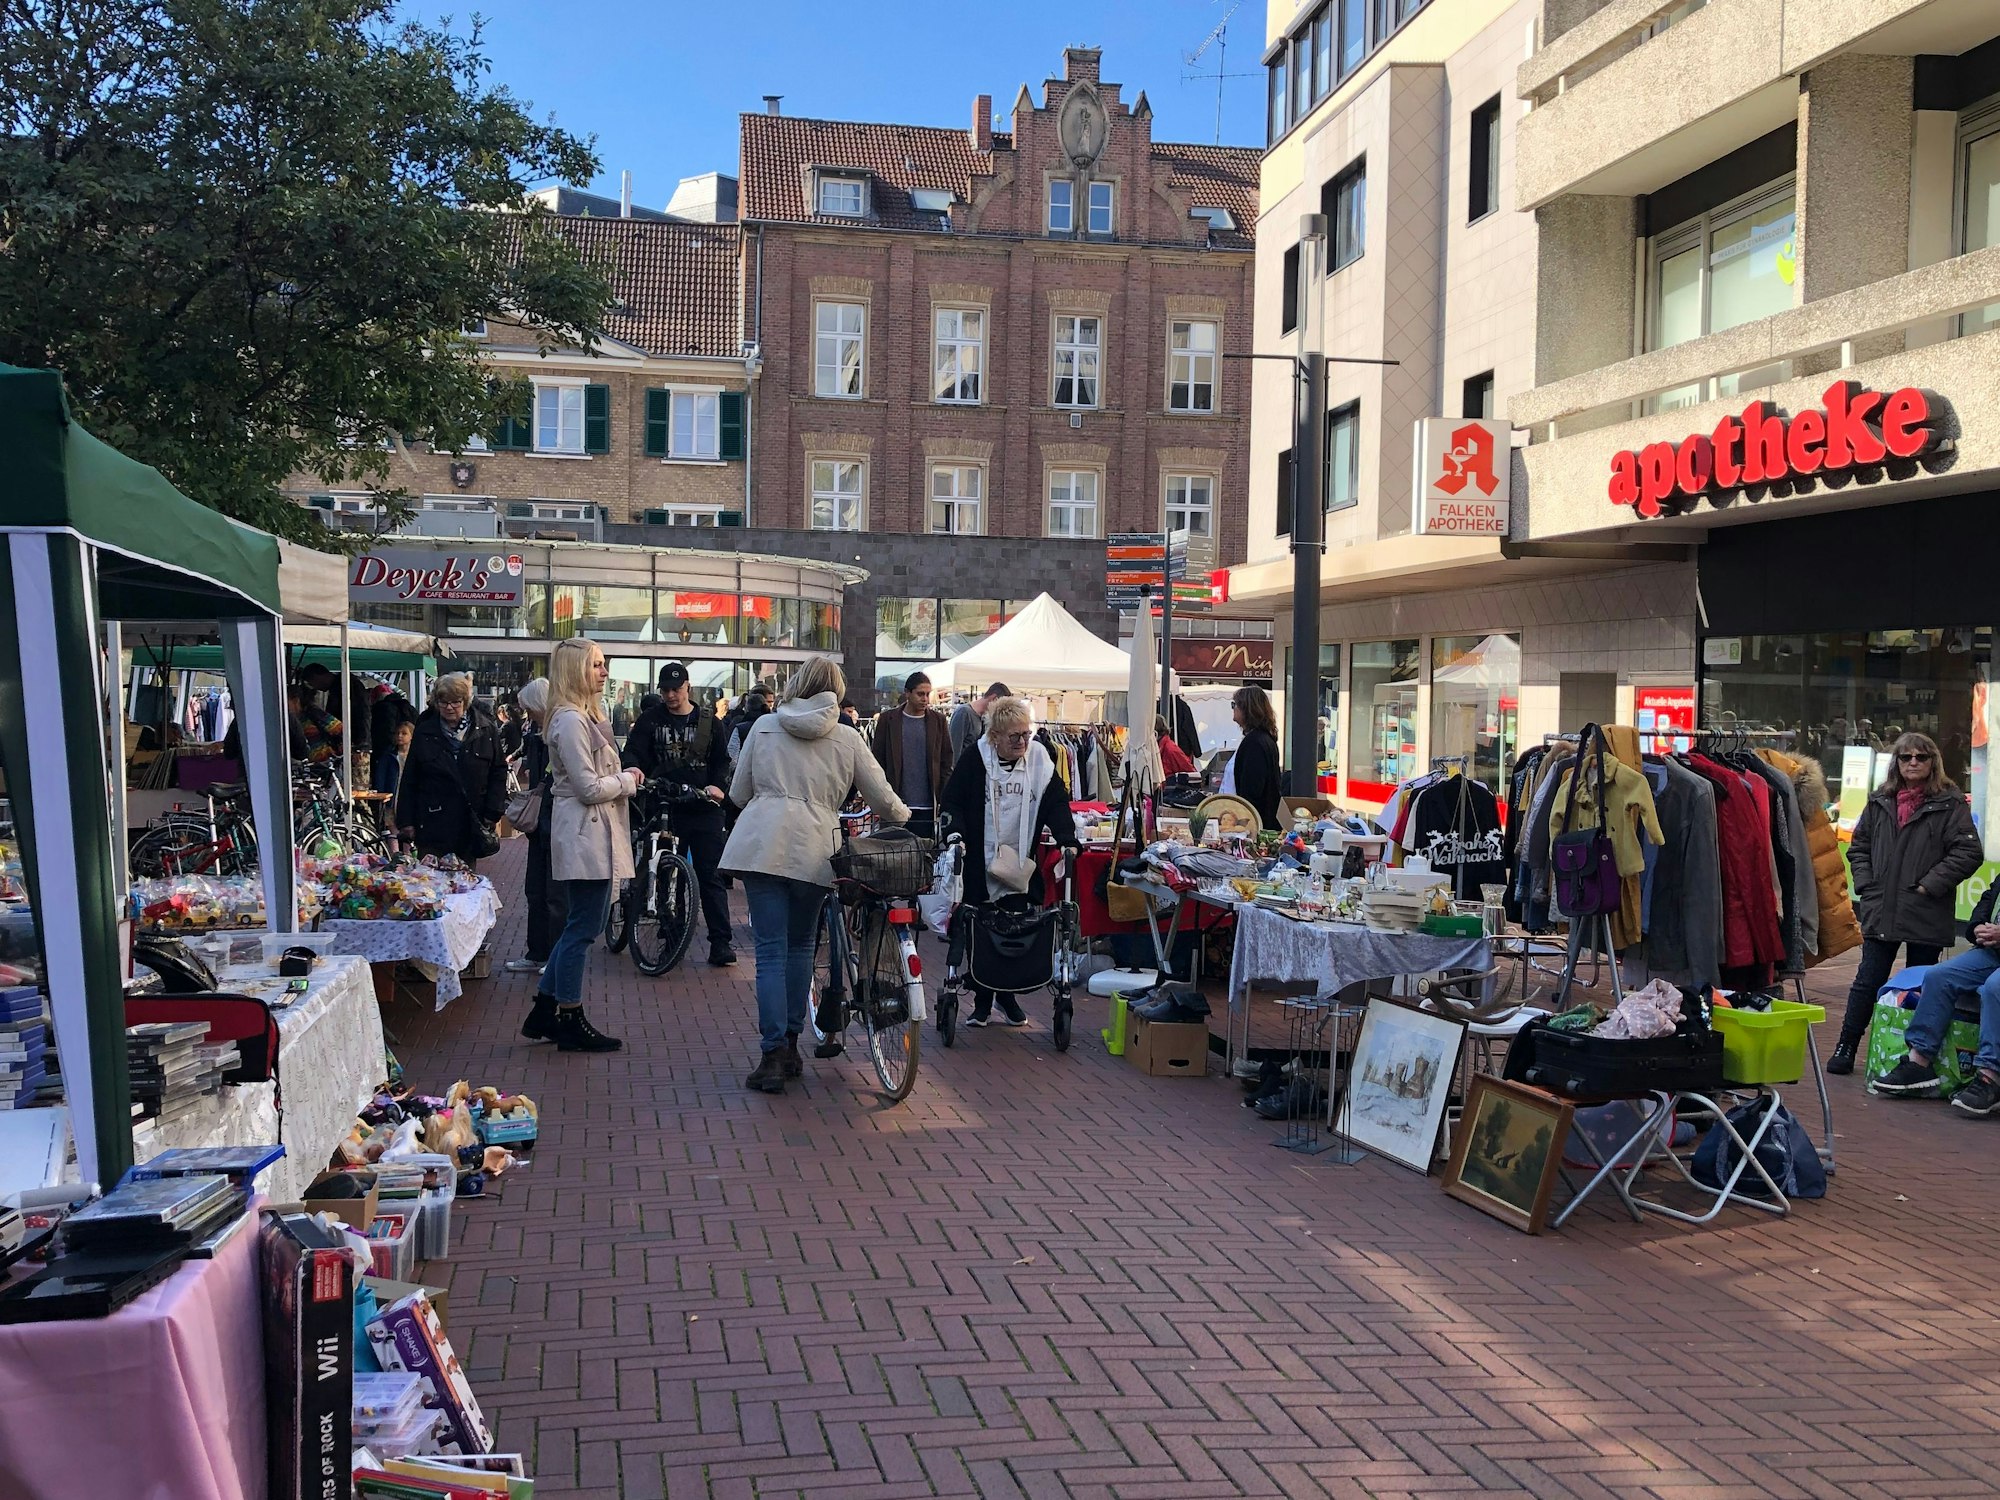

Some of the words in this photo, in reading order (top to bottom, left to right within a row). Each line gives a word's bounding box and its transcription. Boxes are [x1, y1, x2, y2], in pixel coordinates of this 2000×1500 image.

[1608, 380, 1928, 517] apotheke
[1440, 504, 1495, 517] FALKEN
[1428, 517, 1504, 531] APOTHEKE
[350, 556, 490, 599] Deyck's
[1644, 696, 1667, 706] Aktuelle
[1667, 697, 1695, 710] Angebote
[1443, 832, 1491, 852] Frohe
[401, 1327, 421, 1358] SHAKE
[317, 1336, 339, 1381] Wii
[320, 1411, 336, 1454] ROCK
[321, 1457, 335, 1476] OF
[322, 1478, 337, 1500] RS
